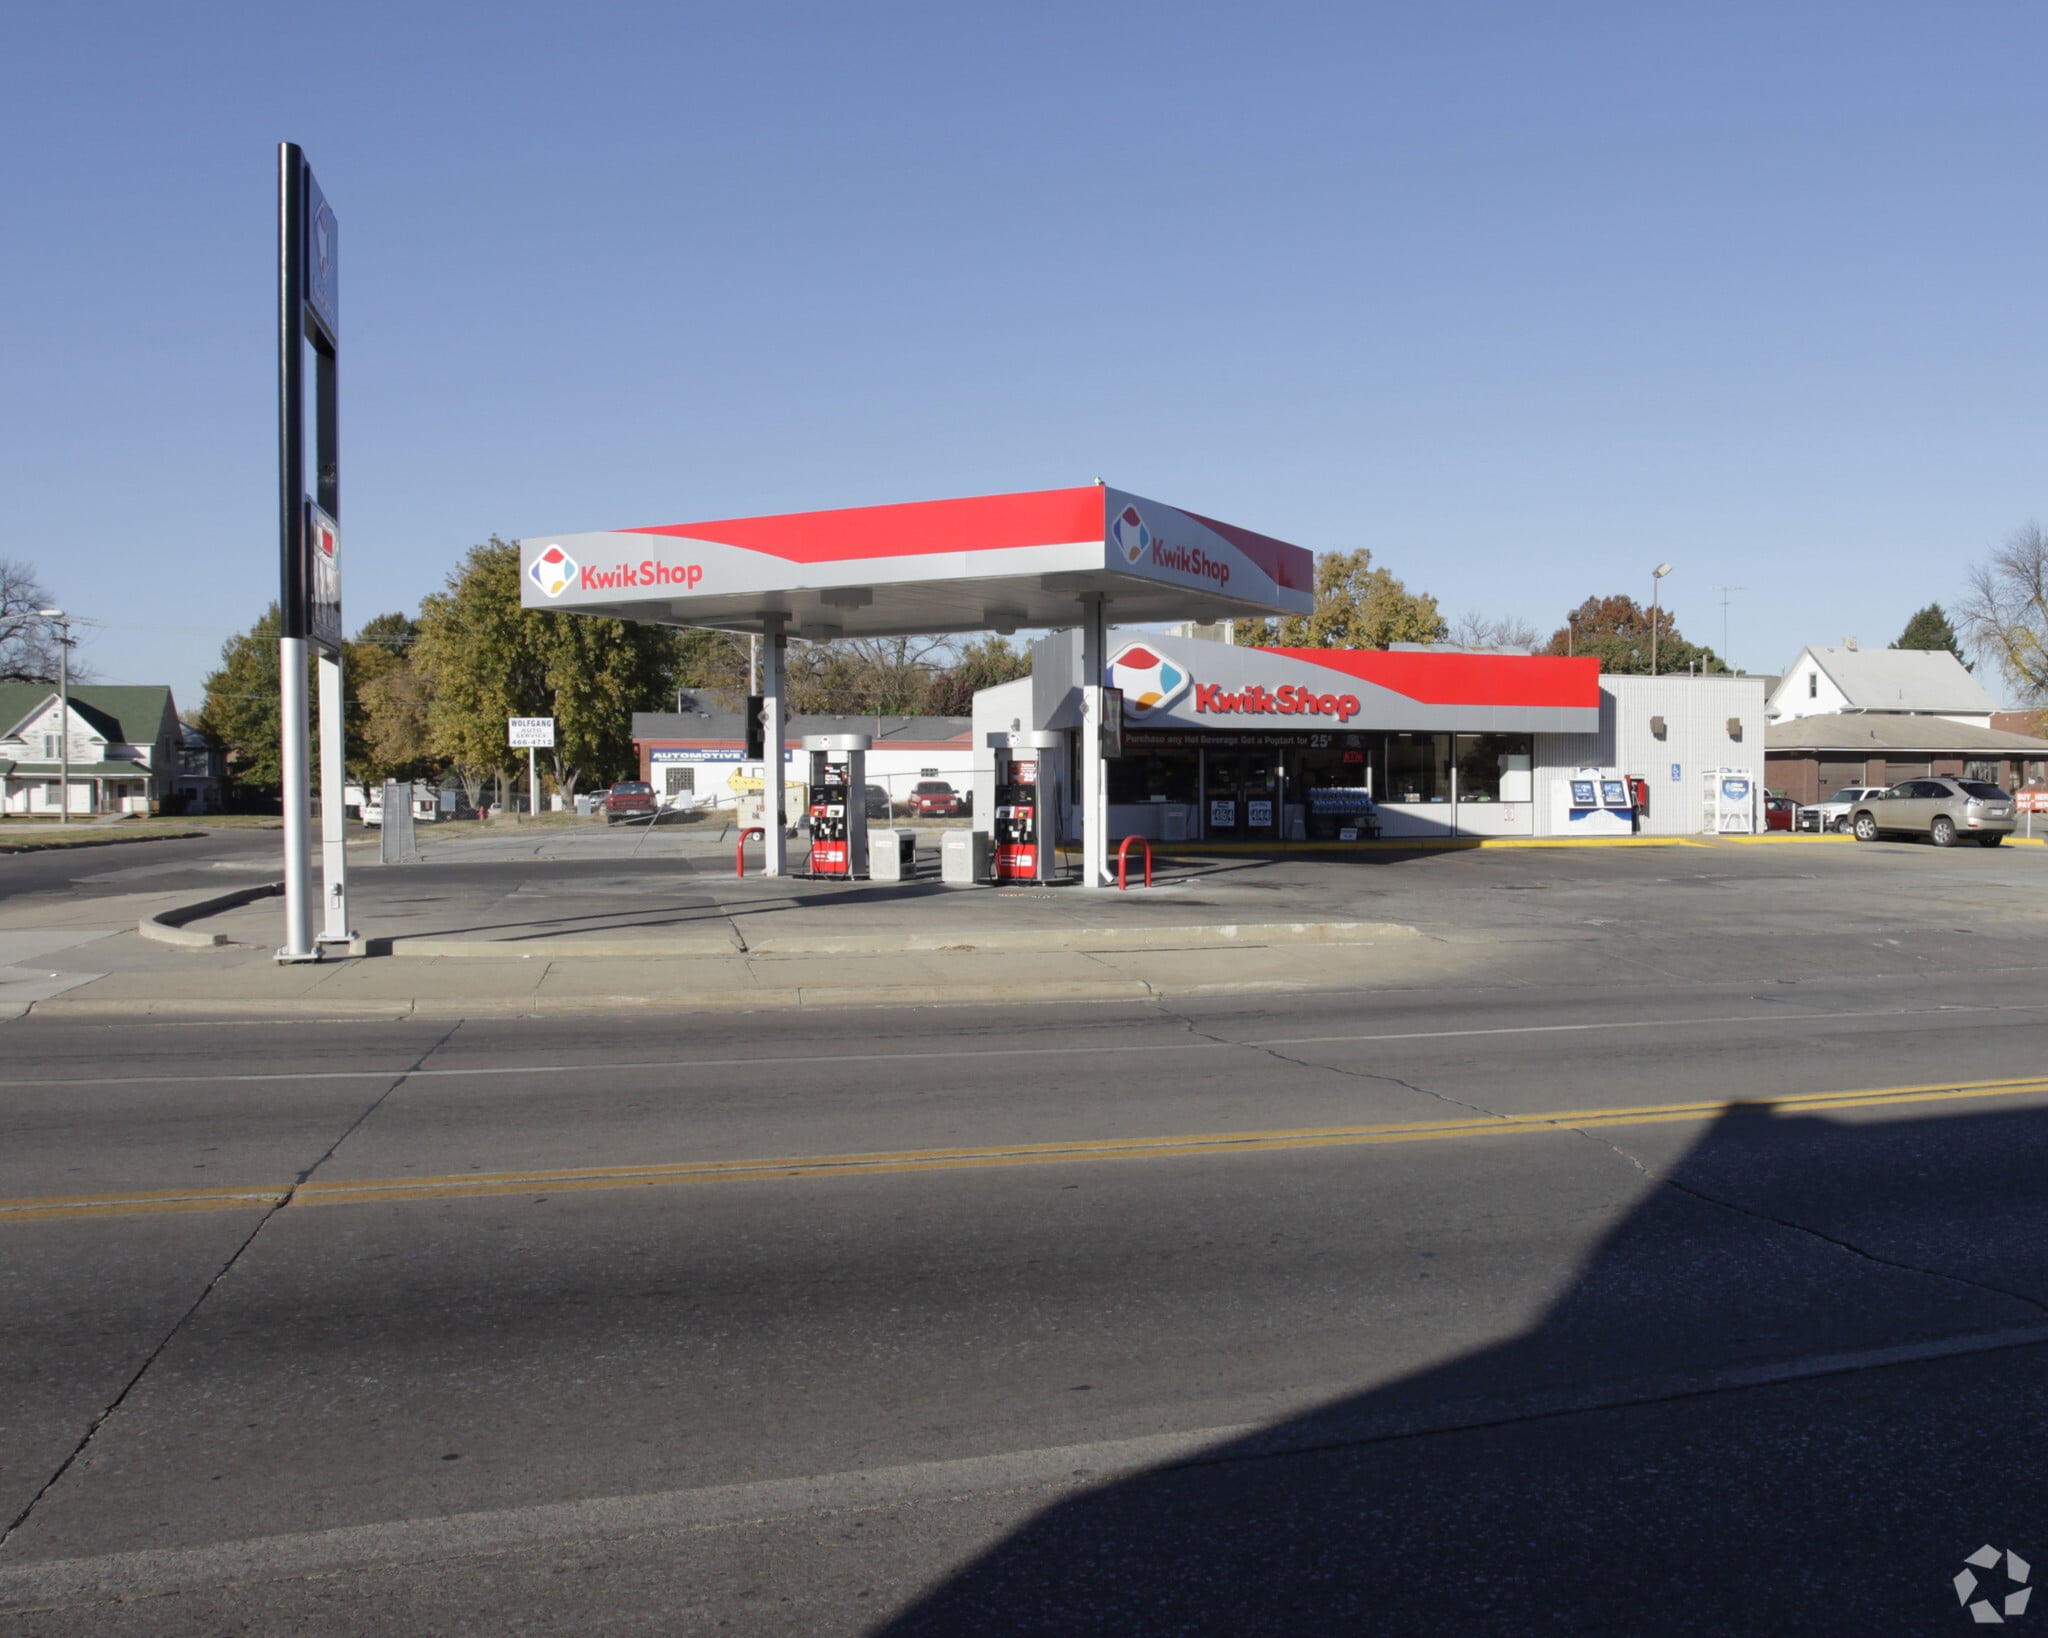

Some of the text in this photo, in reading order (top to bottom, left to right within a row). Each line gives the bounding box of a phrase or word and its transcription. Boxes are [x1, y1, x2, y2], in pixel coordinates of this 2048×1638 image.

[511, 719, 552, 728] WOLFGANG
[1125, 734, 1165, 744] Purchase
[1167, 736, 1183, 745] any
[1184, 735, 1199, 744] Hot
[1200, 735, 1239, 746] Beverage
[1240, 735, 1256, 744] Get
[1264, 735, 1294, 746] Poptart
[1296, 736, 1308, 744] for
[2017, 793, 2031, 801] BUY
